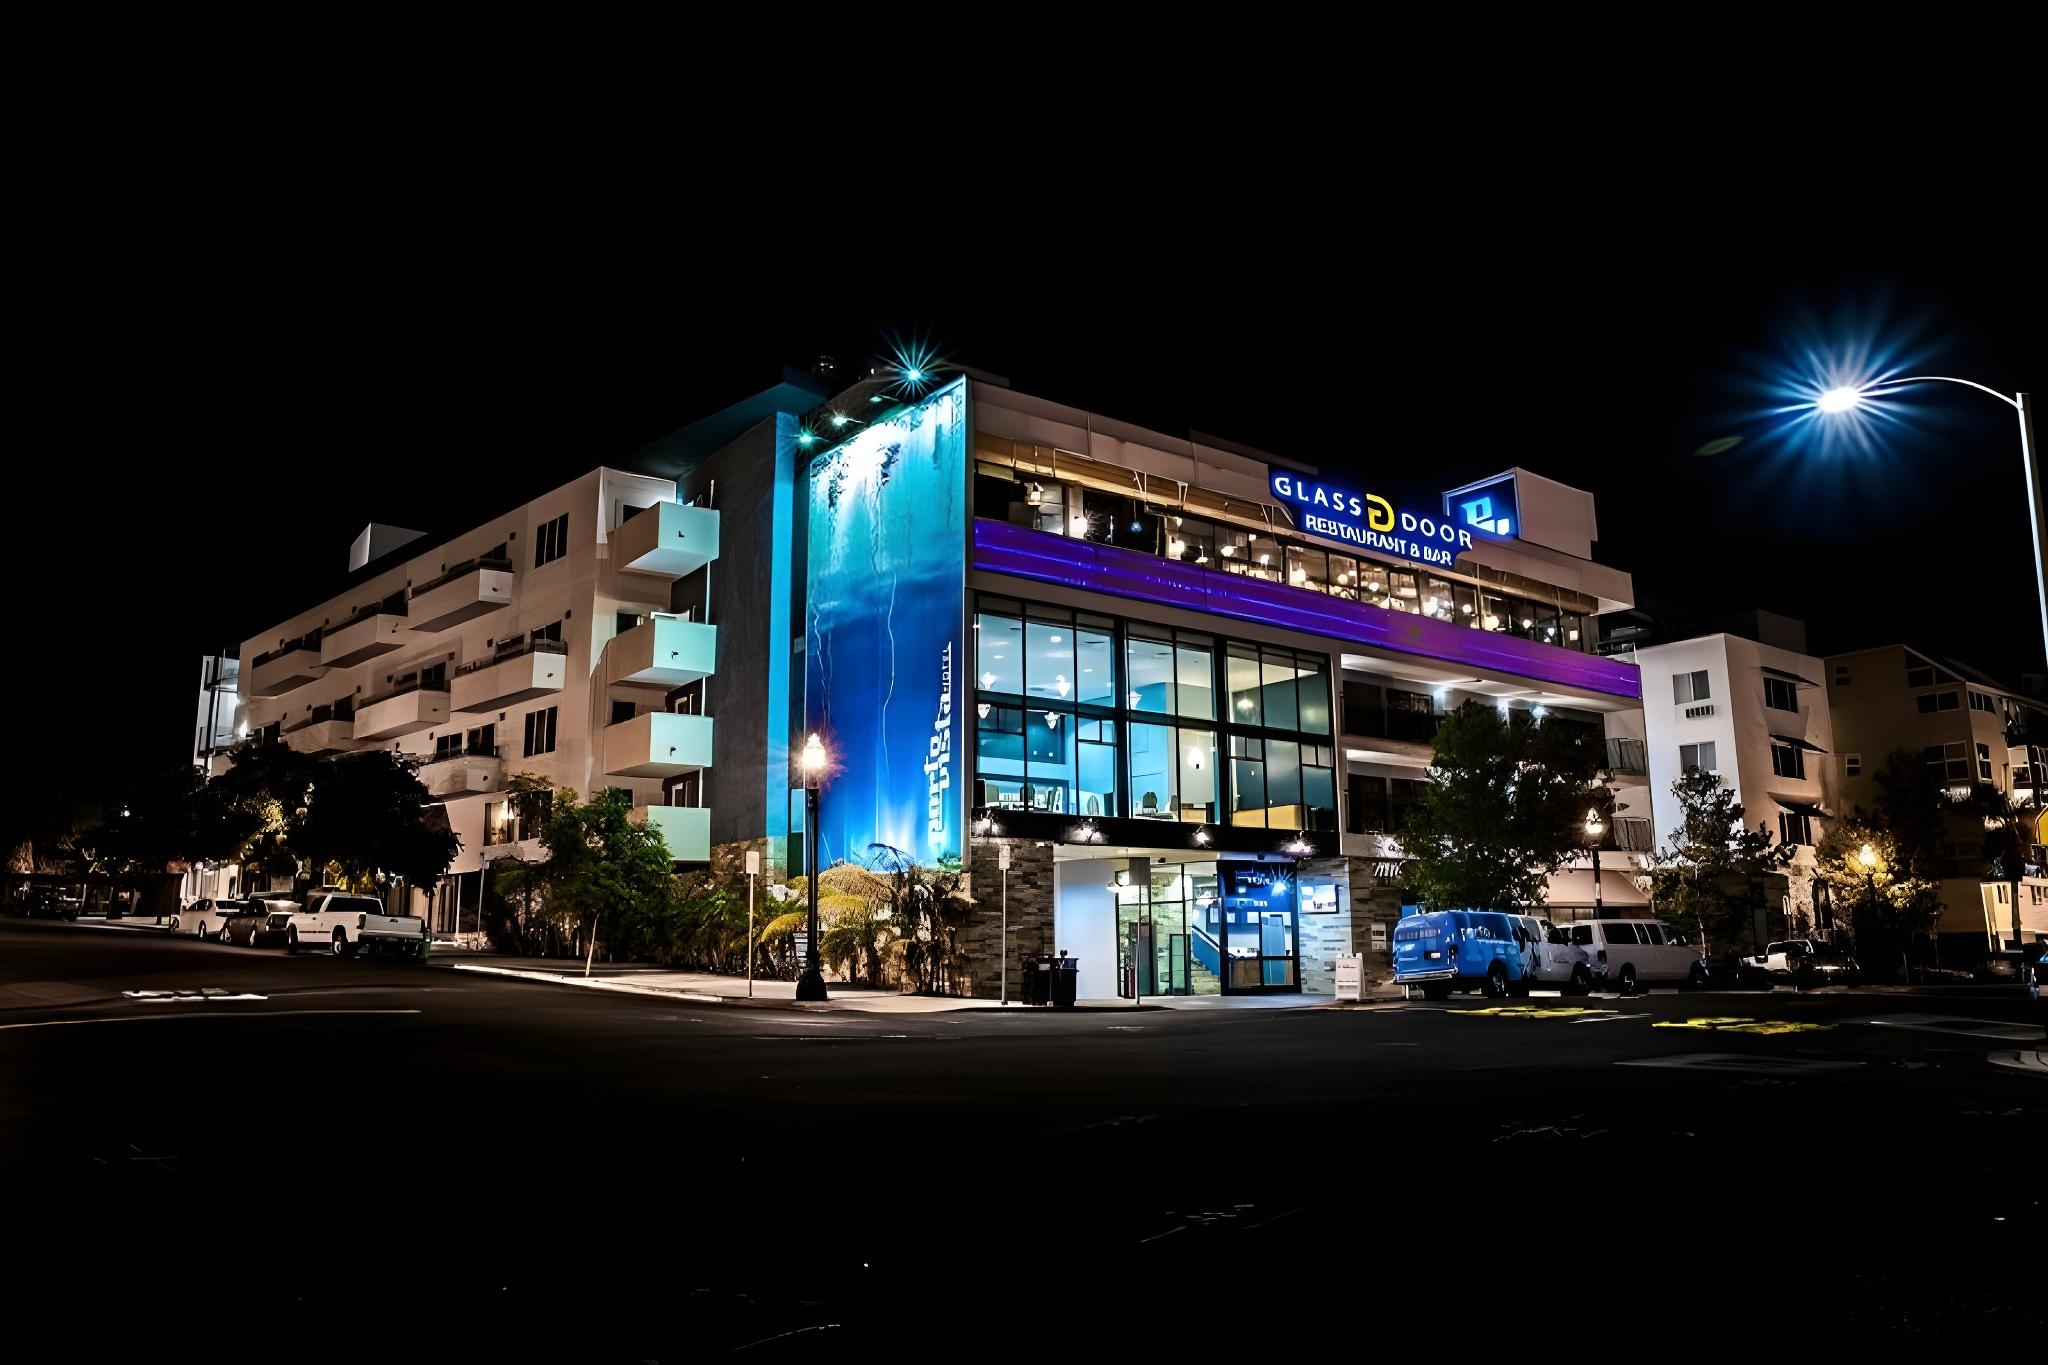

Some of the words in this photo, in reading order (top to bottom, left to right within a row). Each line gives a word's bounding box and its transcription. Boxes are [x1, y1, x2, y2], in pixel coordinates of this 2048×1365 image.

[1274, 476, 1361, 517] GLASS
[1401, 512, 1473, 549] DOOR
[1305, 514, 1407, 556] RESTAURANT
[1423, 547, 1453, 566] BAR
